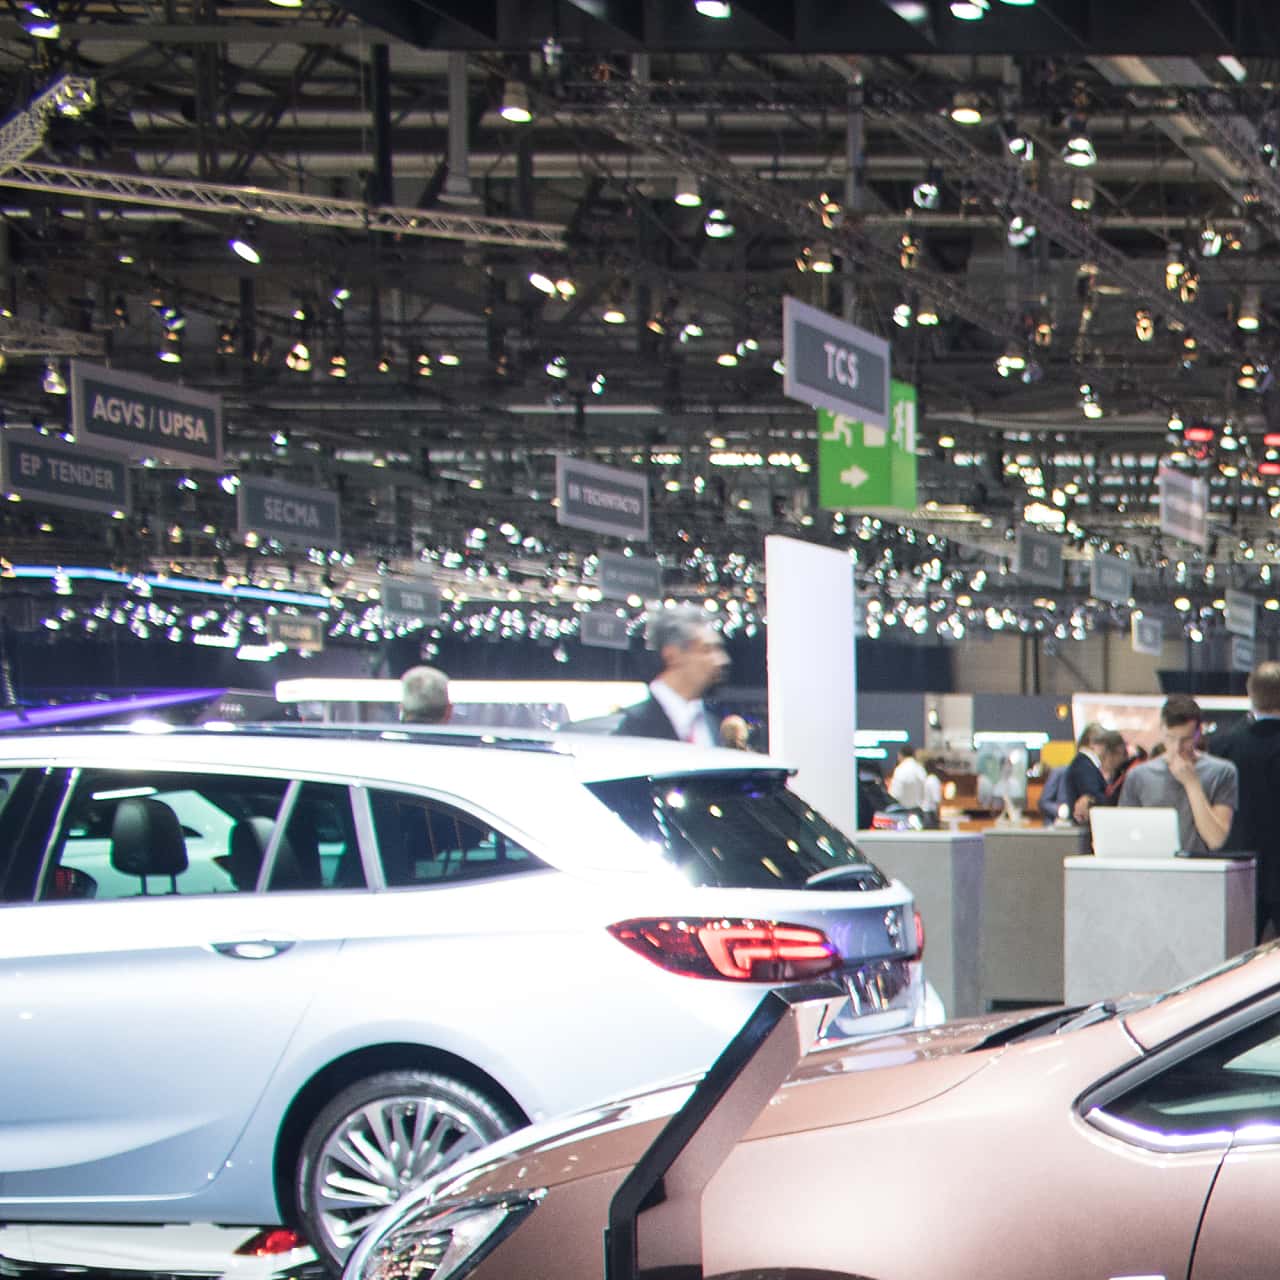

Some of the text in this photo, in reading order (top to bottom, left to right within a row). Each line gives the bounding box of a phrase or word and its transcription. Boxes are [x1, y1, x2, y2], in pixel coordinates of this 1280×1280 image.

[823, 341, 858, 389] TCS
[92, 394, 146, 430] AGVS
[158, 410, 209, 444] UPSA
[20, 452, 115, 491] EP TENDER
[263, 496, 320, 529] SECMA
